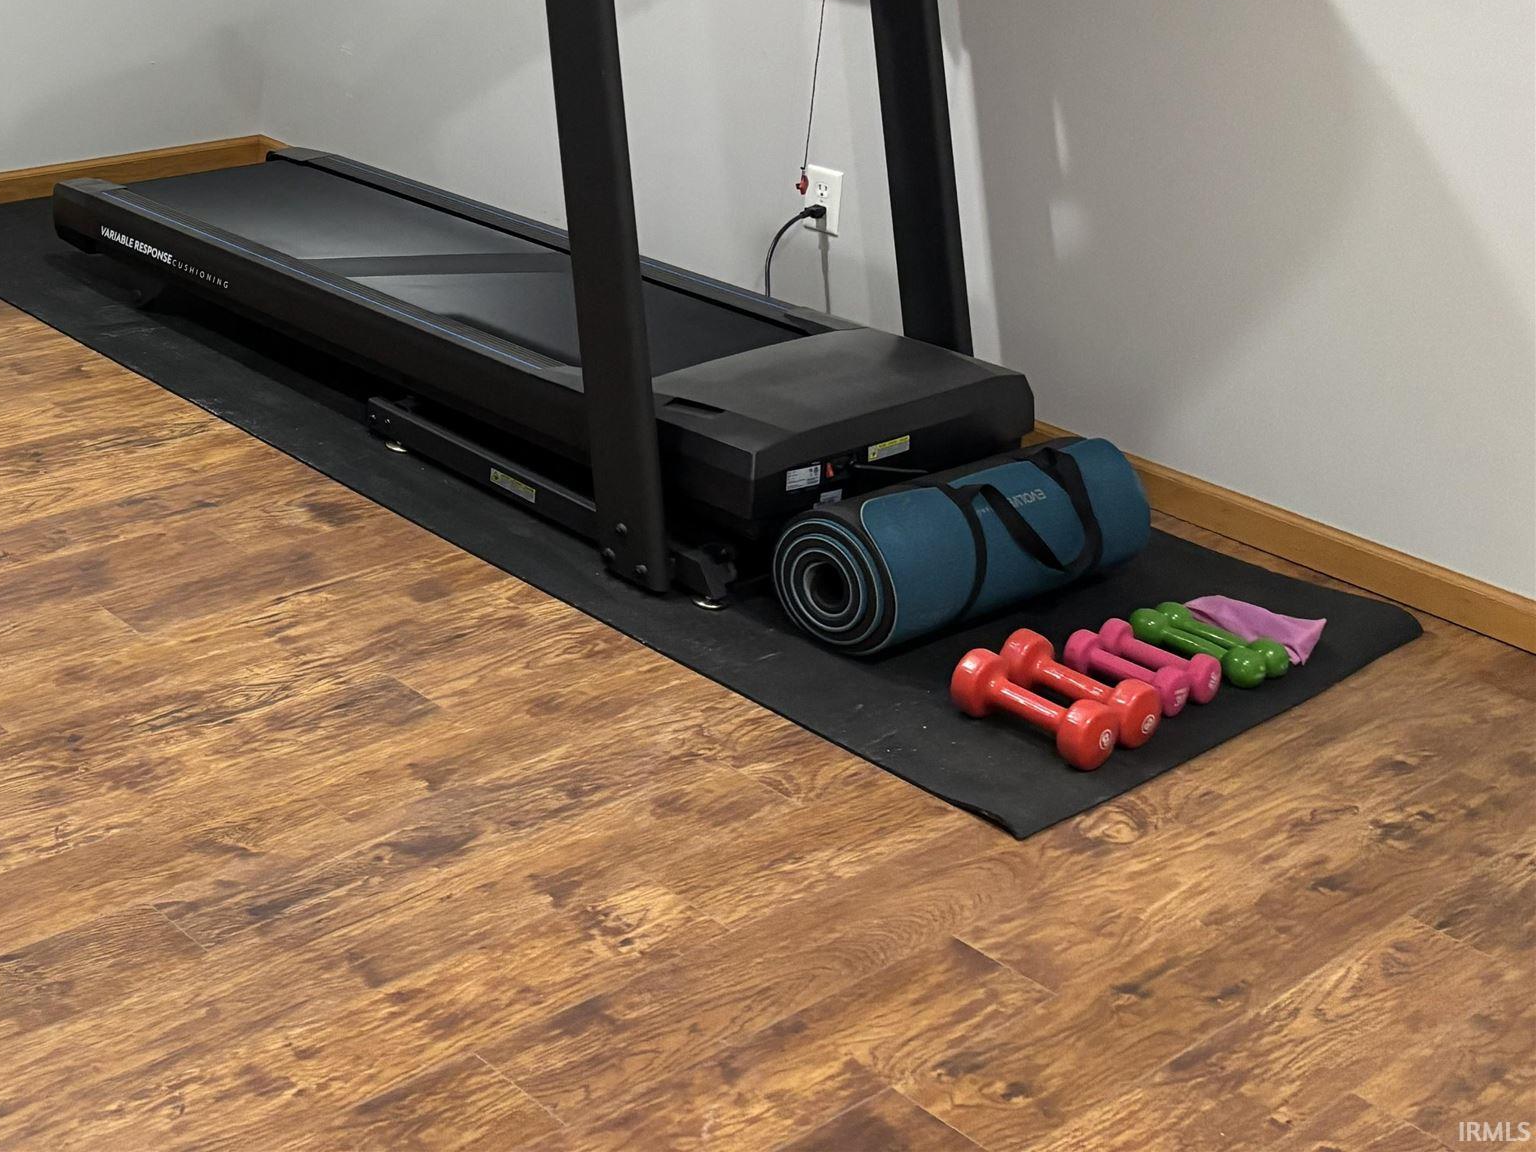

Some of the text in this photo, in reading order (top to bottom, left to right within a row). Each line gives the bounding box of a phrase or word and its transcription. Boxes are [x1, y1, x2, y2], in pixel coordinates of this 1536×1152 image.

[100, 225, 229, 289] VARIABLE RESPONSE CUSHIONING
